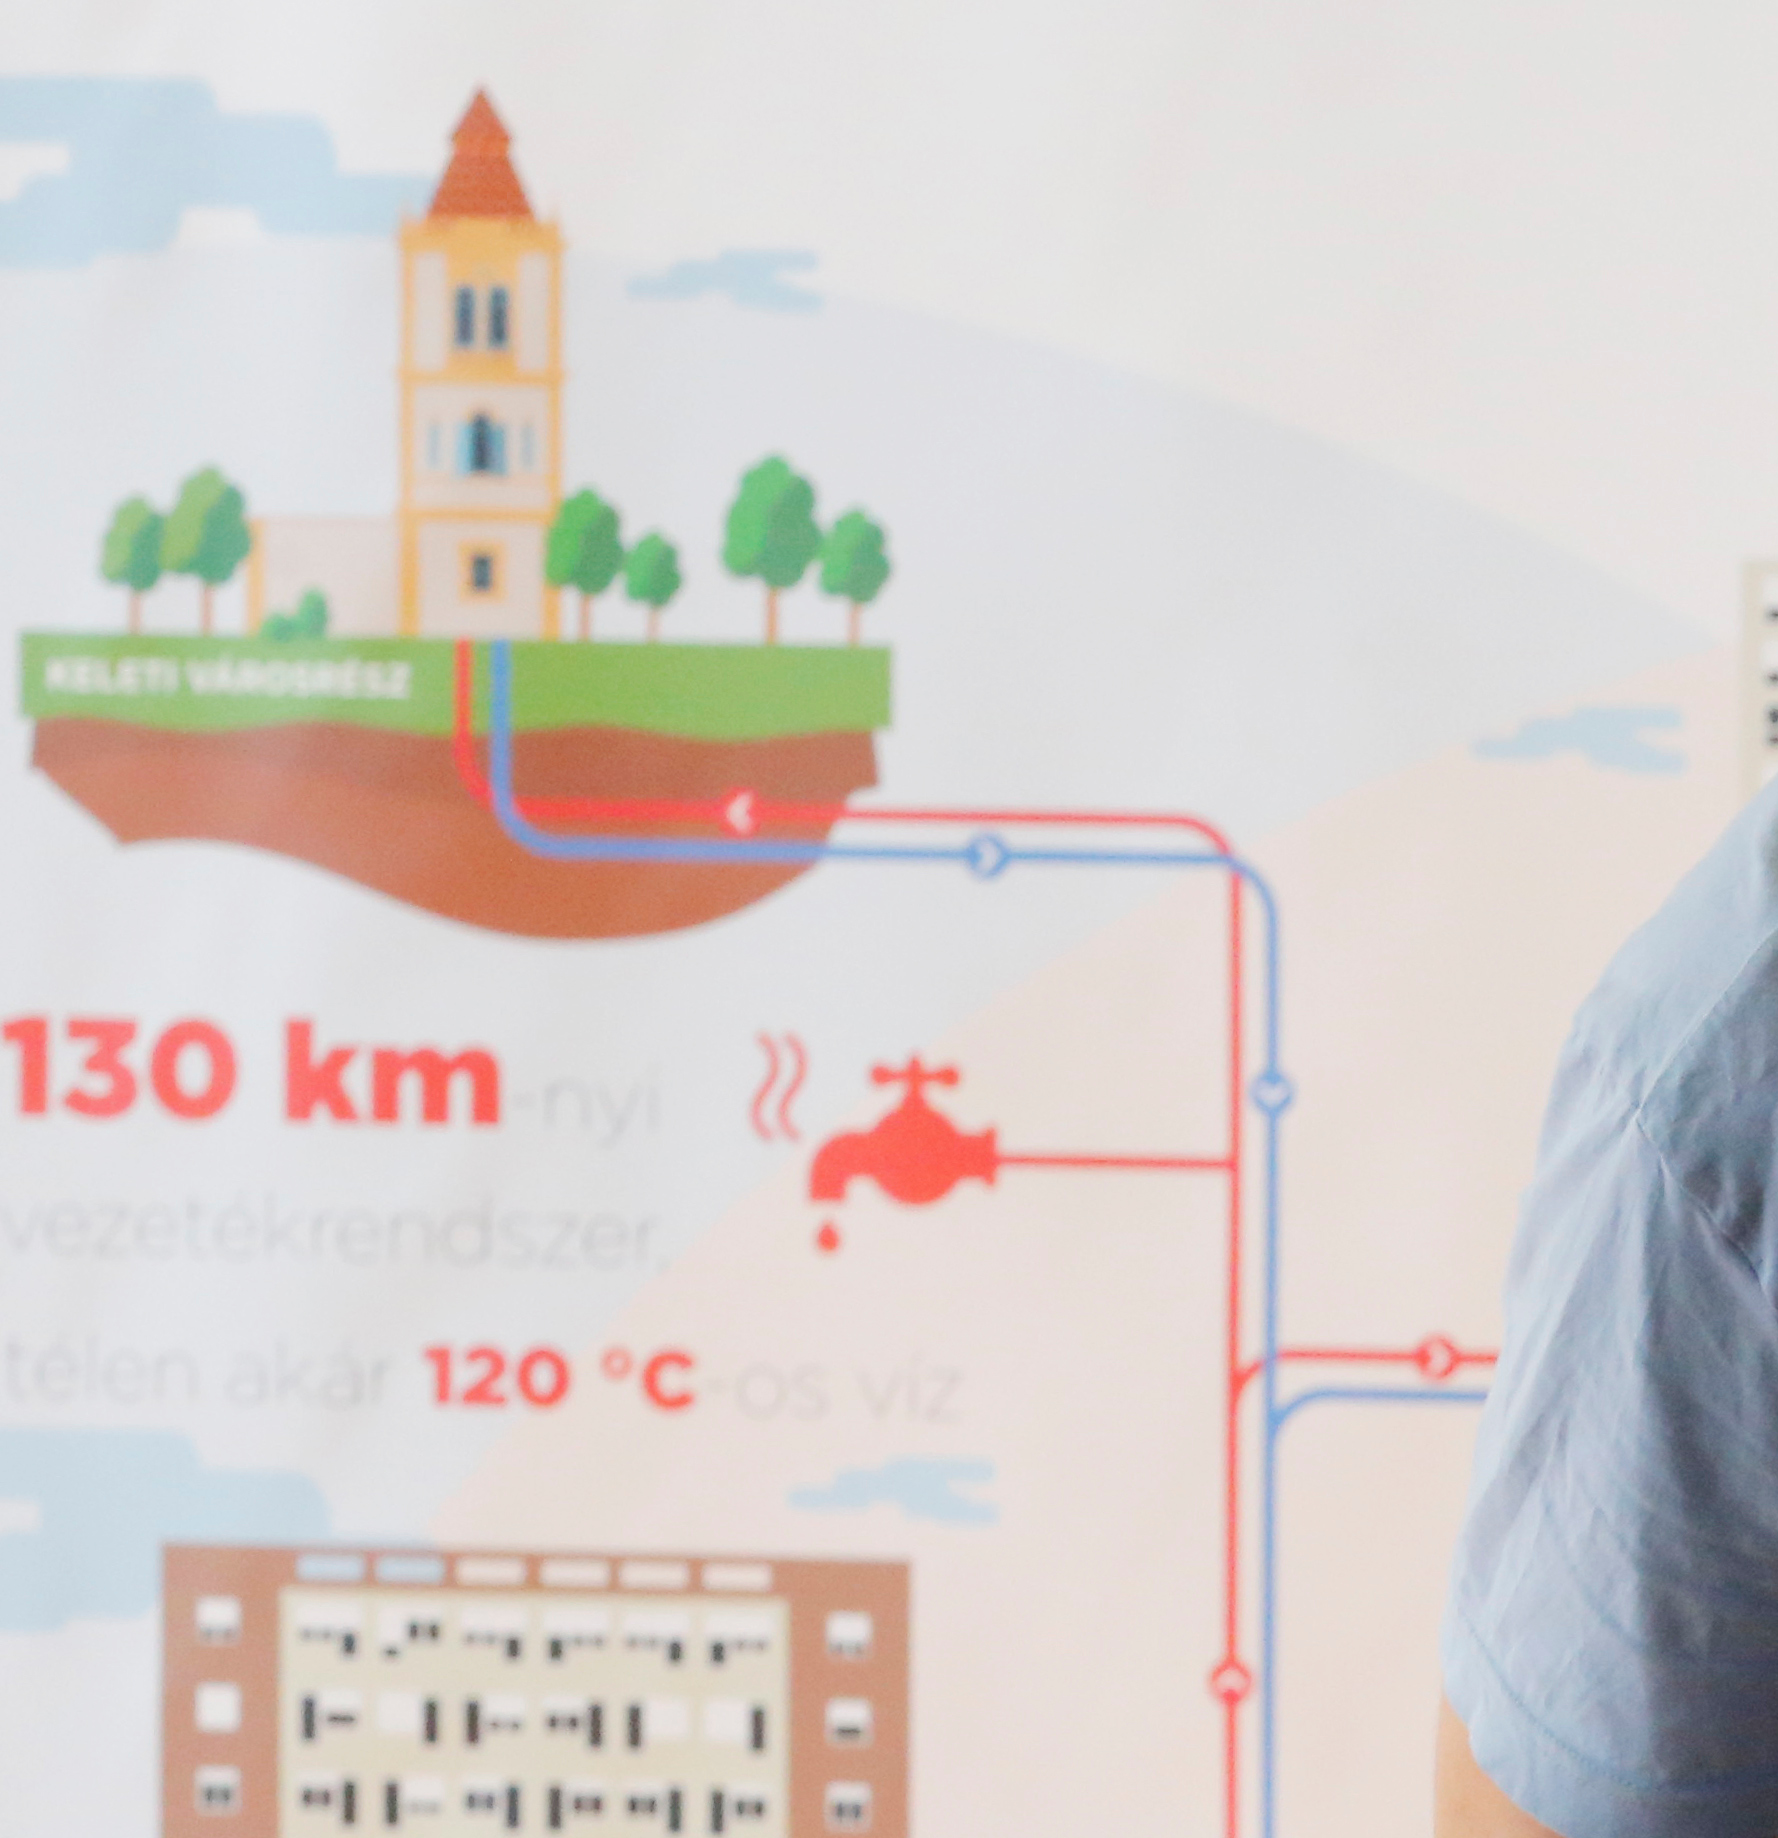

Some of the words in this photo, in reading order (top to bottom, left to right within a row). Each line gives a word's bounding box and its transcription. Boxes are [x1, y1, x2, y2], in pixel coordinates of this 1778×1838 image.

[45, 655, 180, 696] KELETI
[0, 1015, 240, 1122] 130
[4, 1337, 200, 1405] télen
[223, 1340, 392, 1413] akár
[421, 1344, 573, 1411] 120
[856, 1352, 966, 1426] víz
